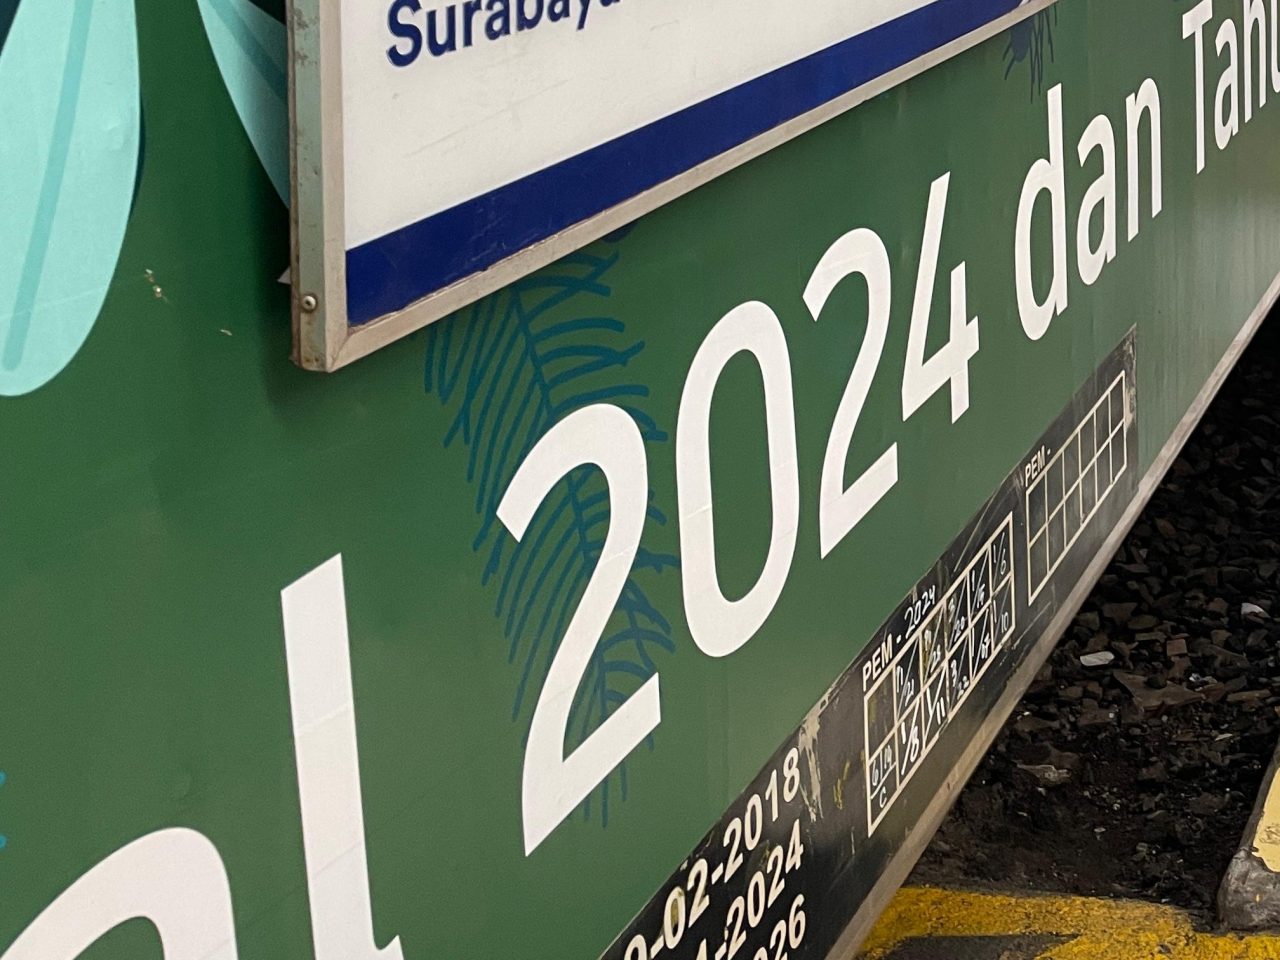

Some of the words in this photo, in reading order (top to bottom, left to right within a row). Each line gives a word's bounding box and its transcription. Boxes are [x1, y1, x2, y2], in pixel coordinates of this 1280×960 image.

[496, 171, 981, 857] 2024
[1014, 77, 1163, 341] dan
[1025, 445, 1046, 487] PEM
[862, 634, 893, 692] PEM
[904, 585, 936, 639] 2024
